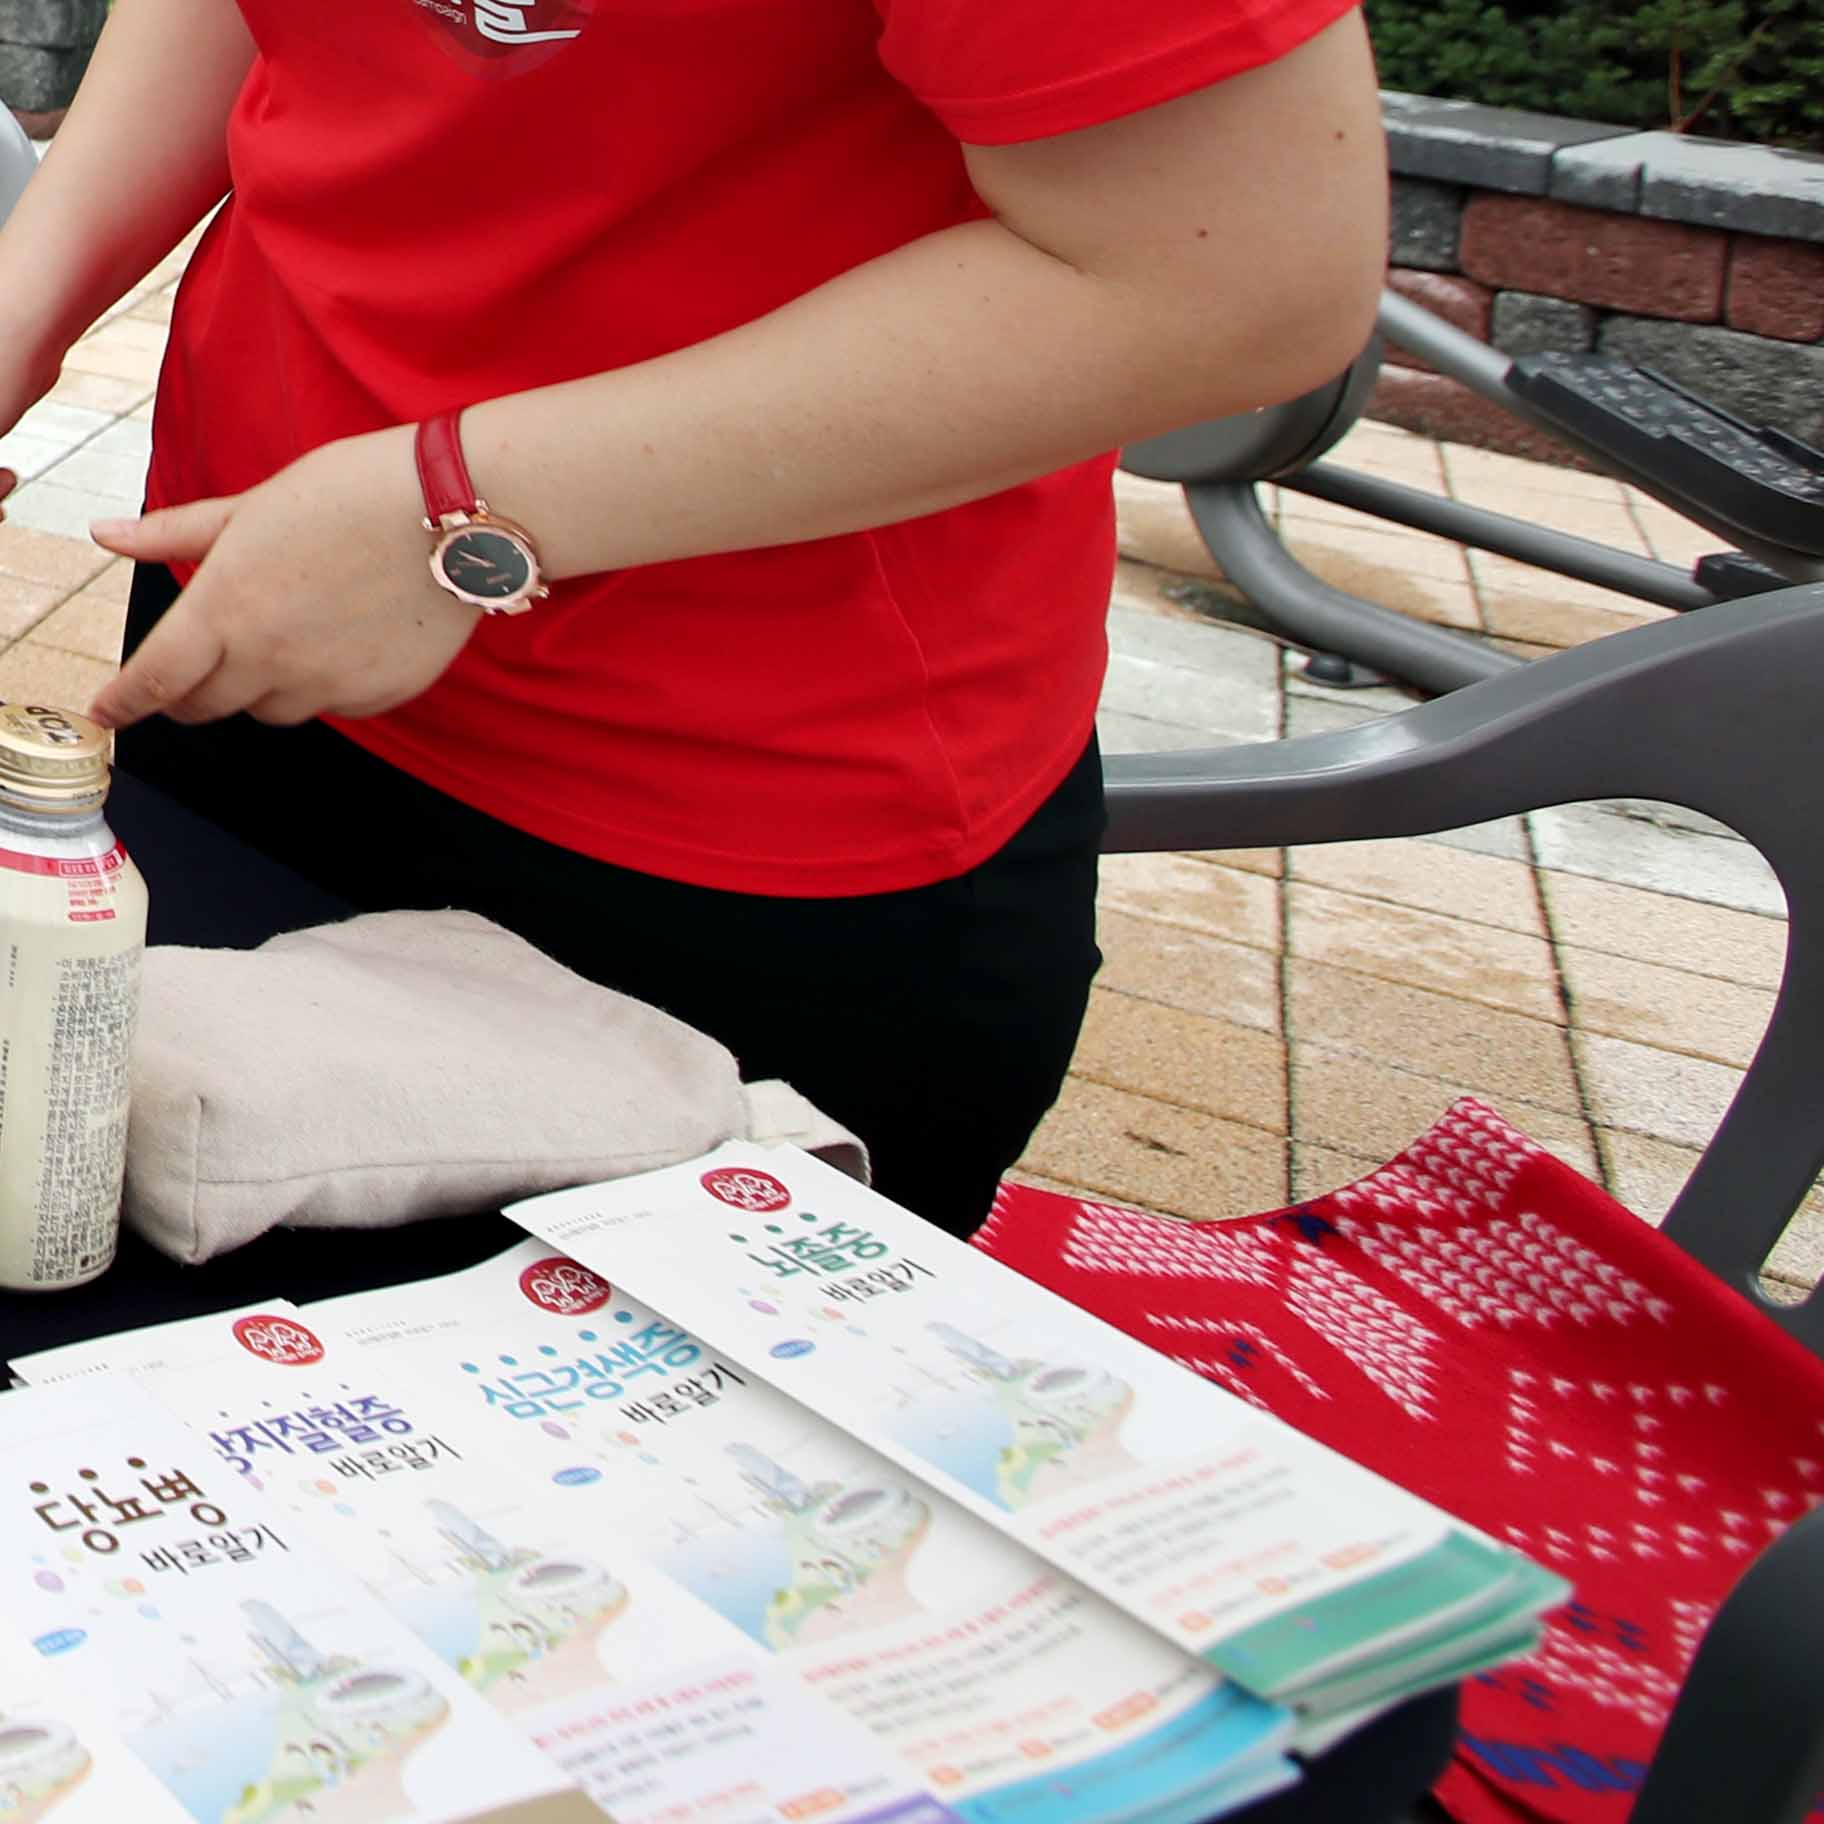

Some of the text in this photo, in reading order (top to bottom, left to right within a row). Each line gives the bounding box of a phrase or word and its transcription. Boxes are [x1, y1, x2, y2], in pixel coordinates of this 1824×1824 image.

[747, 1221, 889, 1278] 뇌졸중
[818, 1257, 937, 1303] 바로알기
[479, 1320, 703, 1420] 심근경색증
[619, 1362, 749, 1426] 바로알기
[329, 1434, 463, 1481] 바로알기
[33, 1468, 227, 1554] 당뇨병
[141, 1523, 290, 1575] 바로알기
